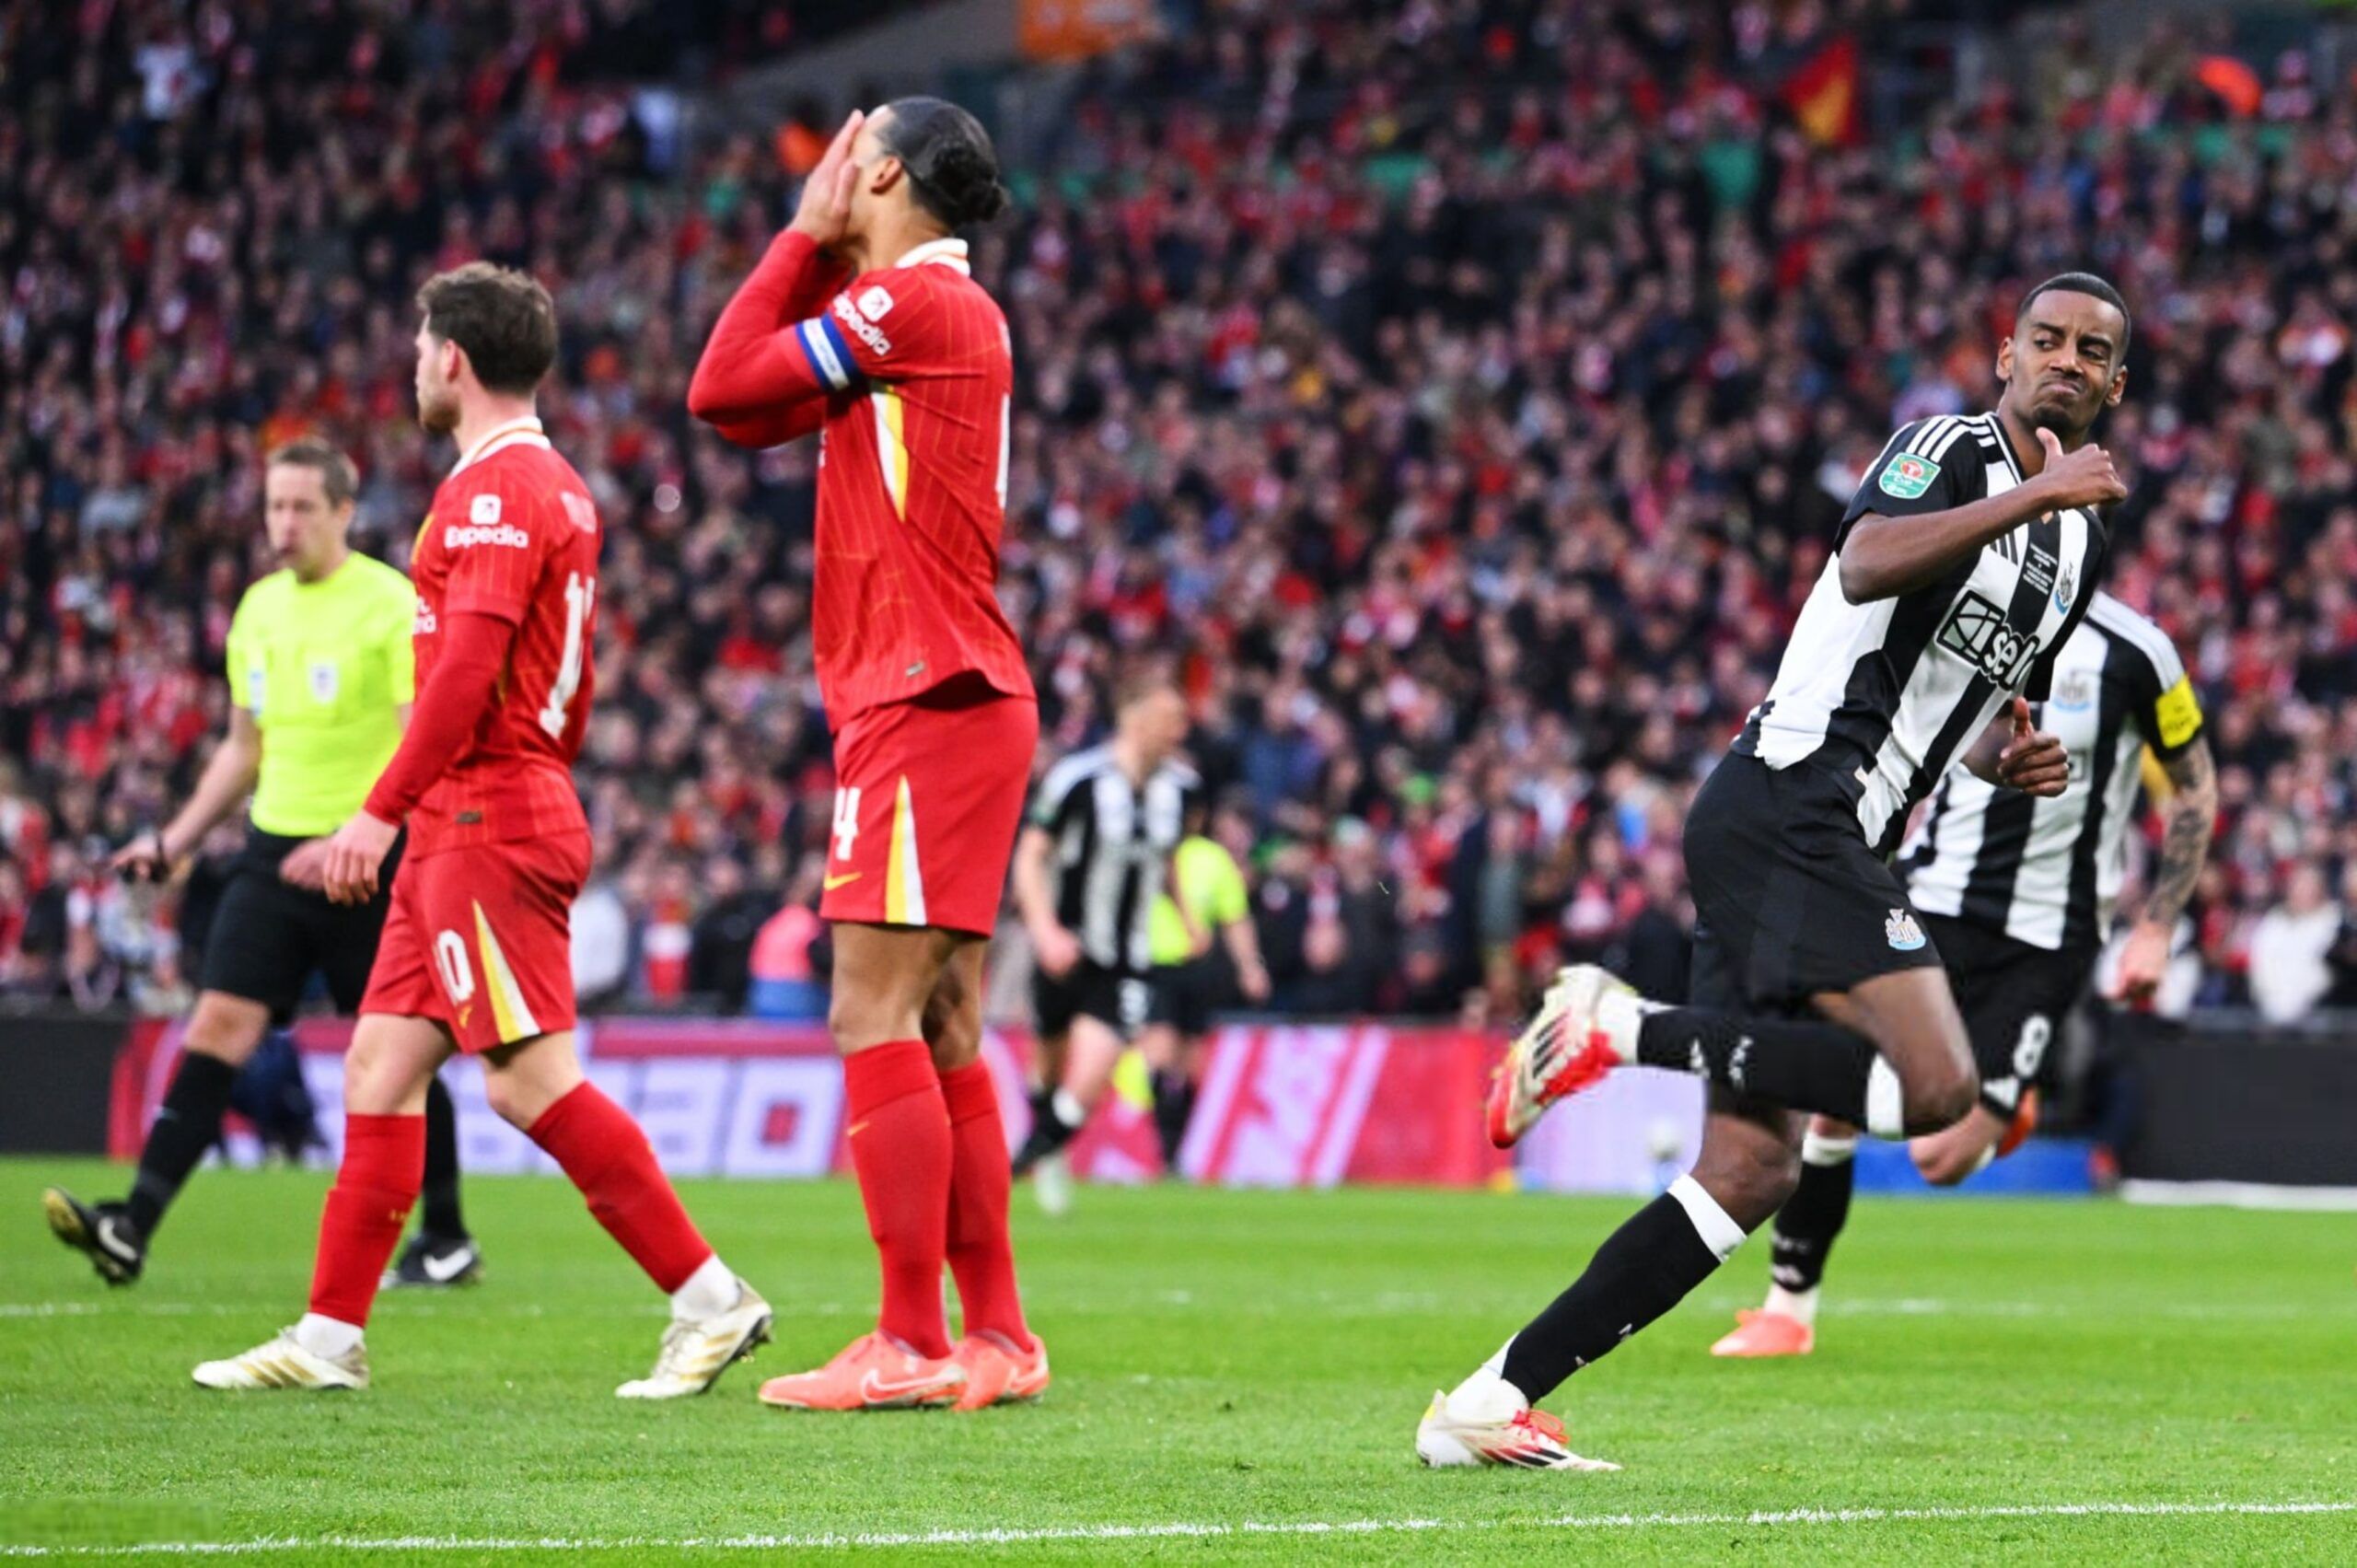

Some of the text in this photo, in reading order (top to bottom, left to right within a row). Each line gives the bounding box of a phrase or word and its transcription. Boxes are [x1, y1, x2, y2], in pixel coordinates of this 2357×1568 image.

[833, 290, 891, 357] Expedia
[445, 523, 528, 549] Expedia
[833, 786, 862, 861] 4
[2013, 1013, 2050, 1077] 8
